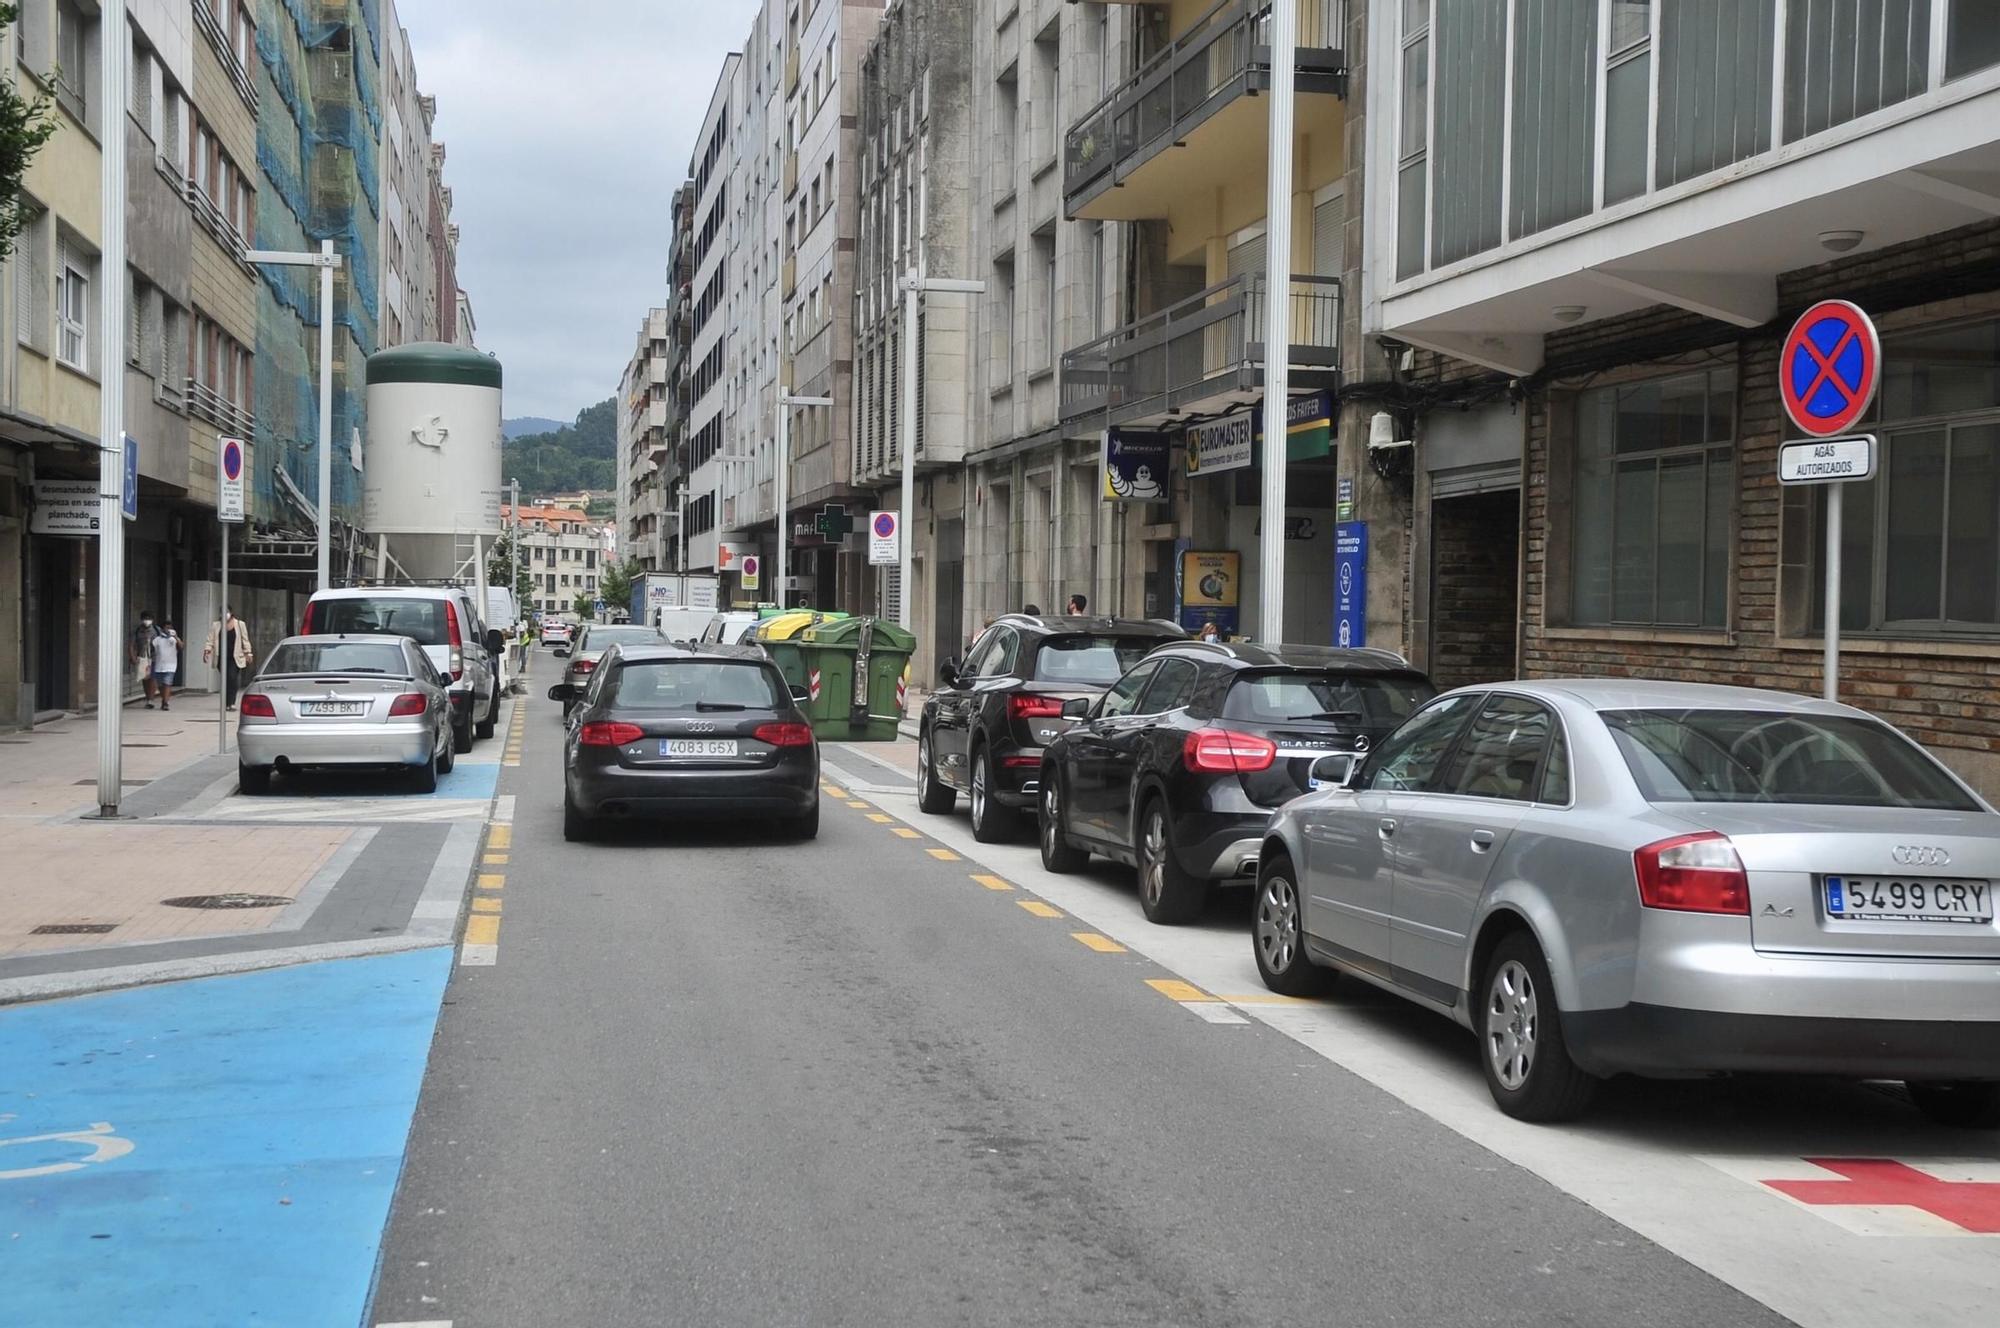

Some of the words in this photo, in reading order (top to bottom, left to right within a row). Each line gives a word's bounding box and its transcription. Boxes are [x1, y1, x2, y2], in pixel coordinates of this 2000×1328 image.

[1200, 418, 1250, 452] EUROMASTER
[1813, 444, 1836, 459] AGÁS
[1796, 460, 1853, 476] AUTORIZADOS
[48, 510, 90, 520] planchado
[308, 702, 335, 713] 7493
[340, 702, 359, 713] BKT
[669, 740, 704, 754] 4083
[1848, 881, 1925, 909] 5499
[1934, 884, 1984, 912] CRY
[1760, 903, 1794, 918] A4
